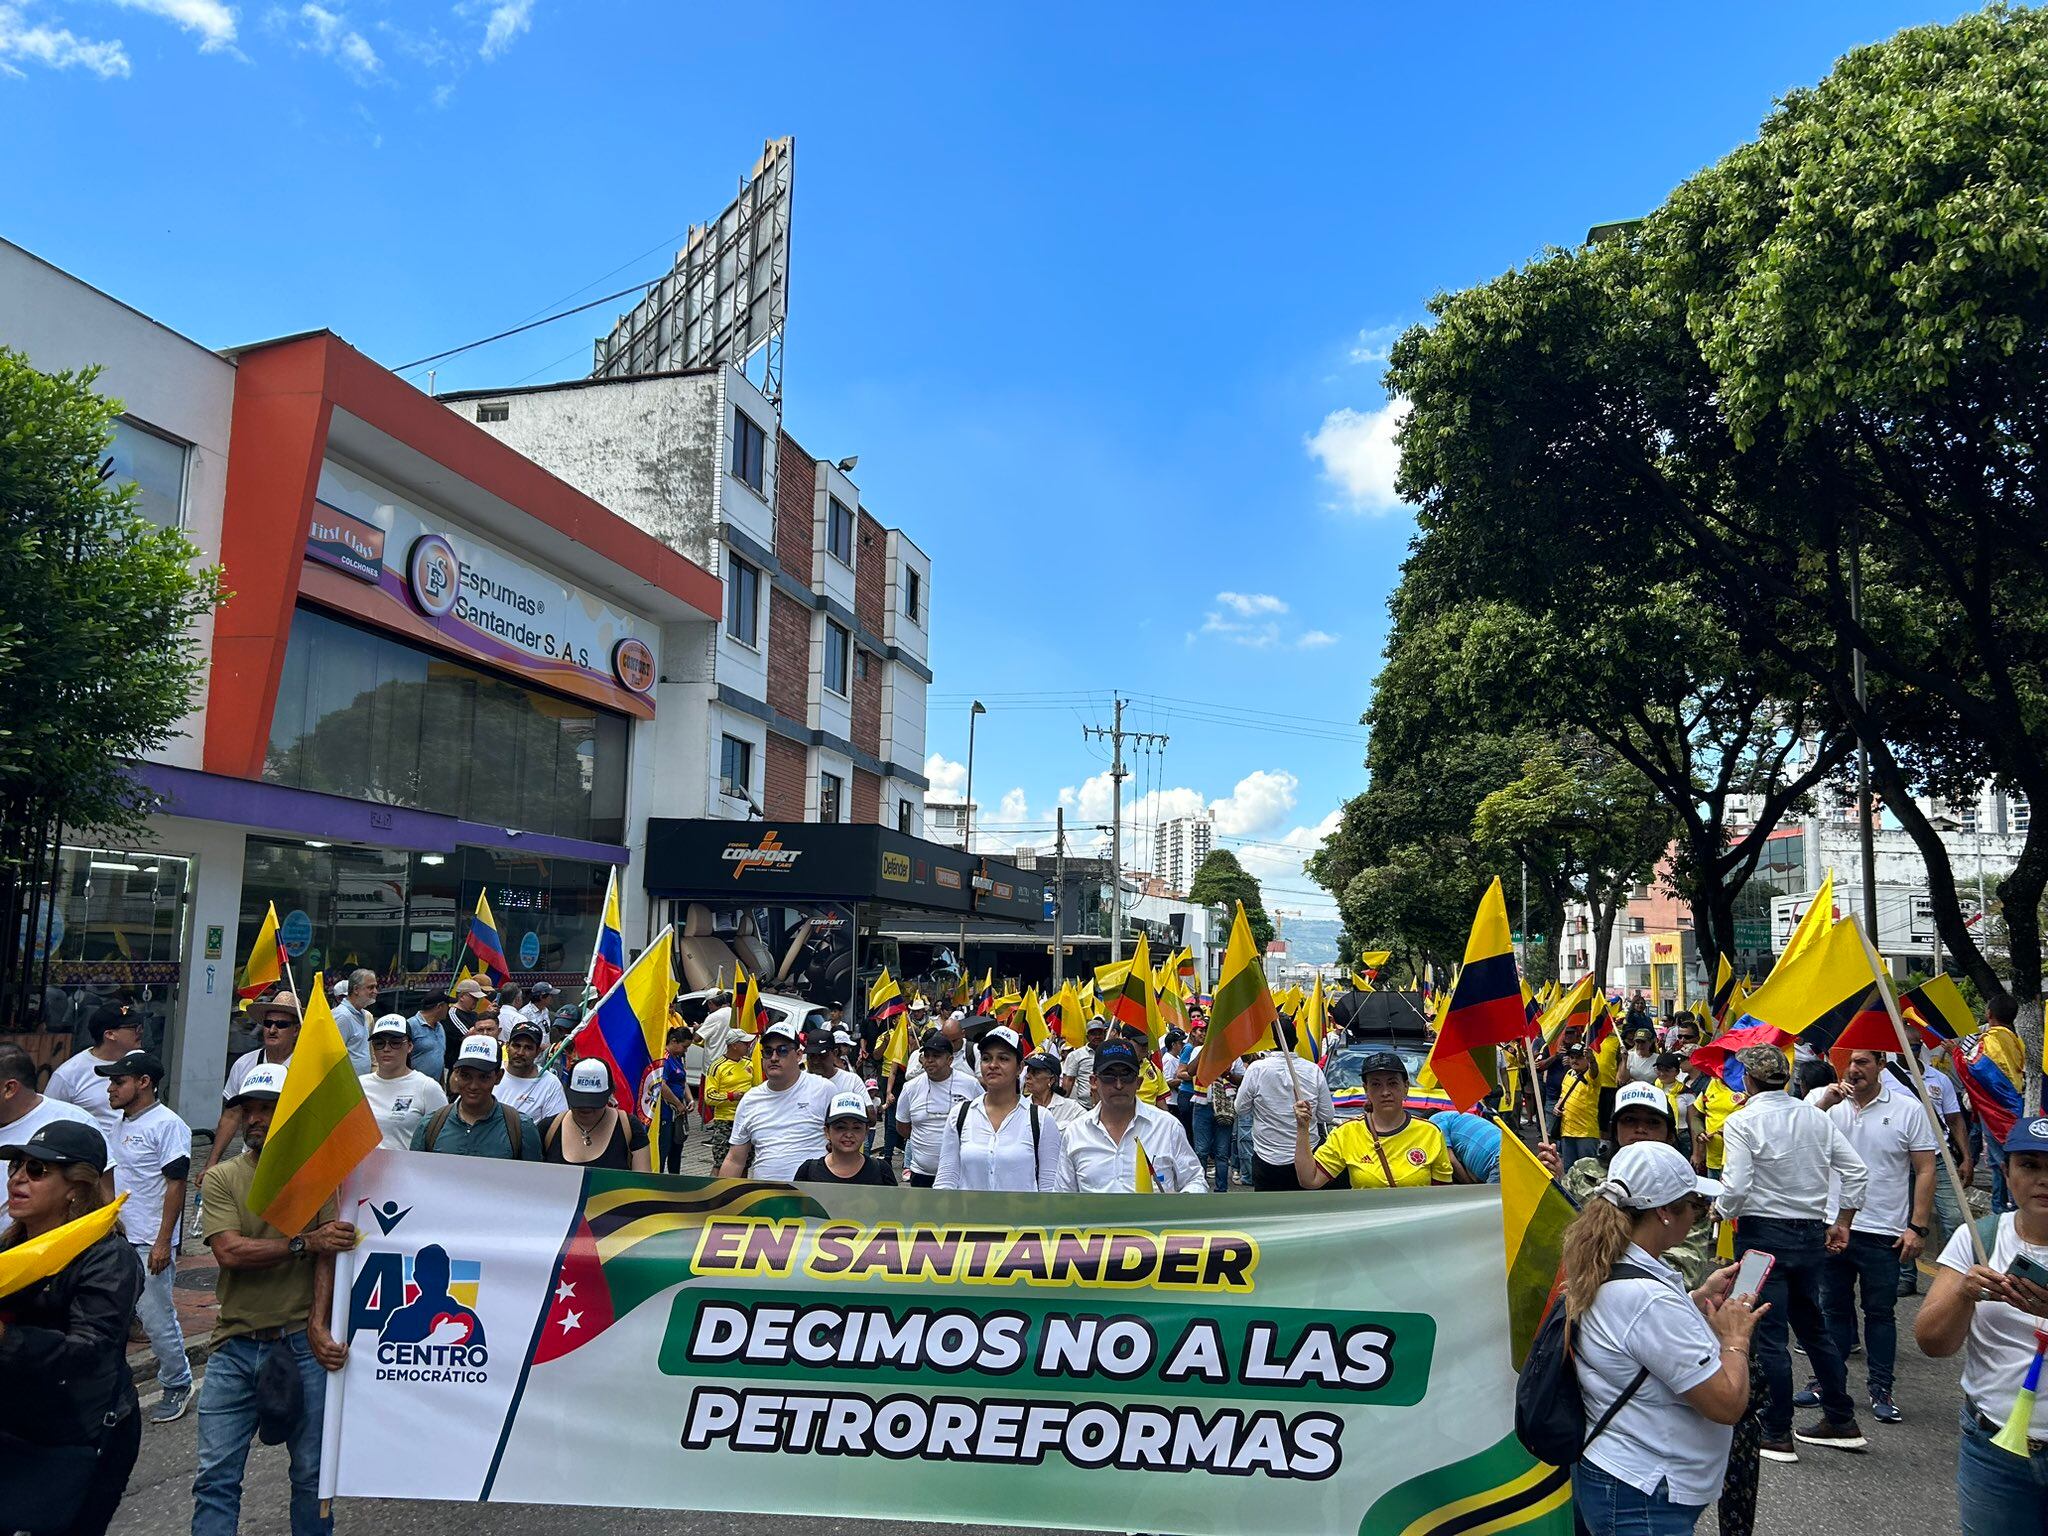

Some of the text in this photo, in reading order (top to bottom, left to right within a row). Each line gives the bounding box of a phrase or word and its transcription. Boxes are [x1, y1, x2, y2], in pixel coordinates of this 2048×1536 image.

[311, 521, 340, 541] First
[341, 555, 379, 577] COLCHONES
[456, 596, 541, 650] Santander
[721, 848, 802, 863] COMFORT
[1621, 1091, 1654, 1102] MEDINA
[697, 1222, 1256, 1286] EN SANTANDER
[377, 1343, 488, 1368] CENTRO
[692, 1306, 1388, 1384] DECIMOS NO A LAS
[376, 1367, 488, 1383] DEMOCRÁTICO
[687, 1393, 1342, 1472] PETROREFORMAS
